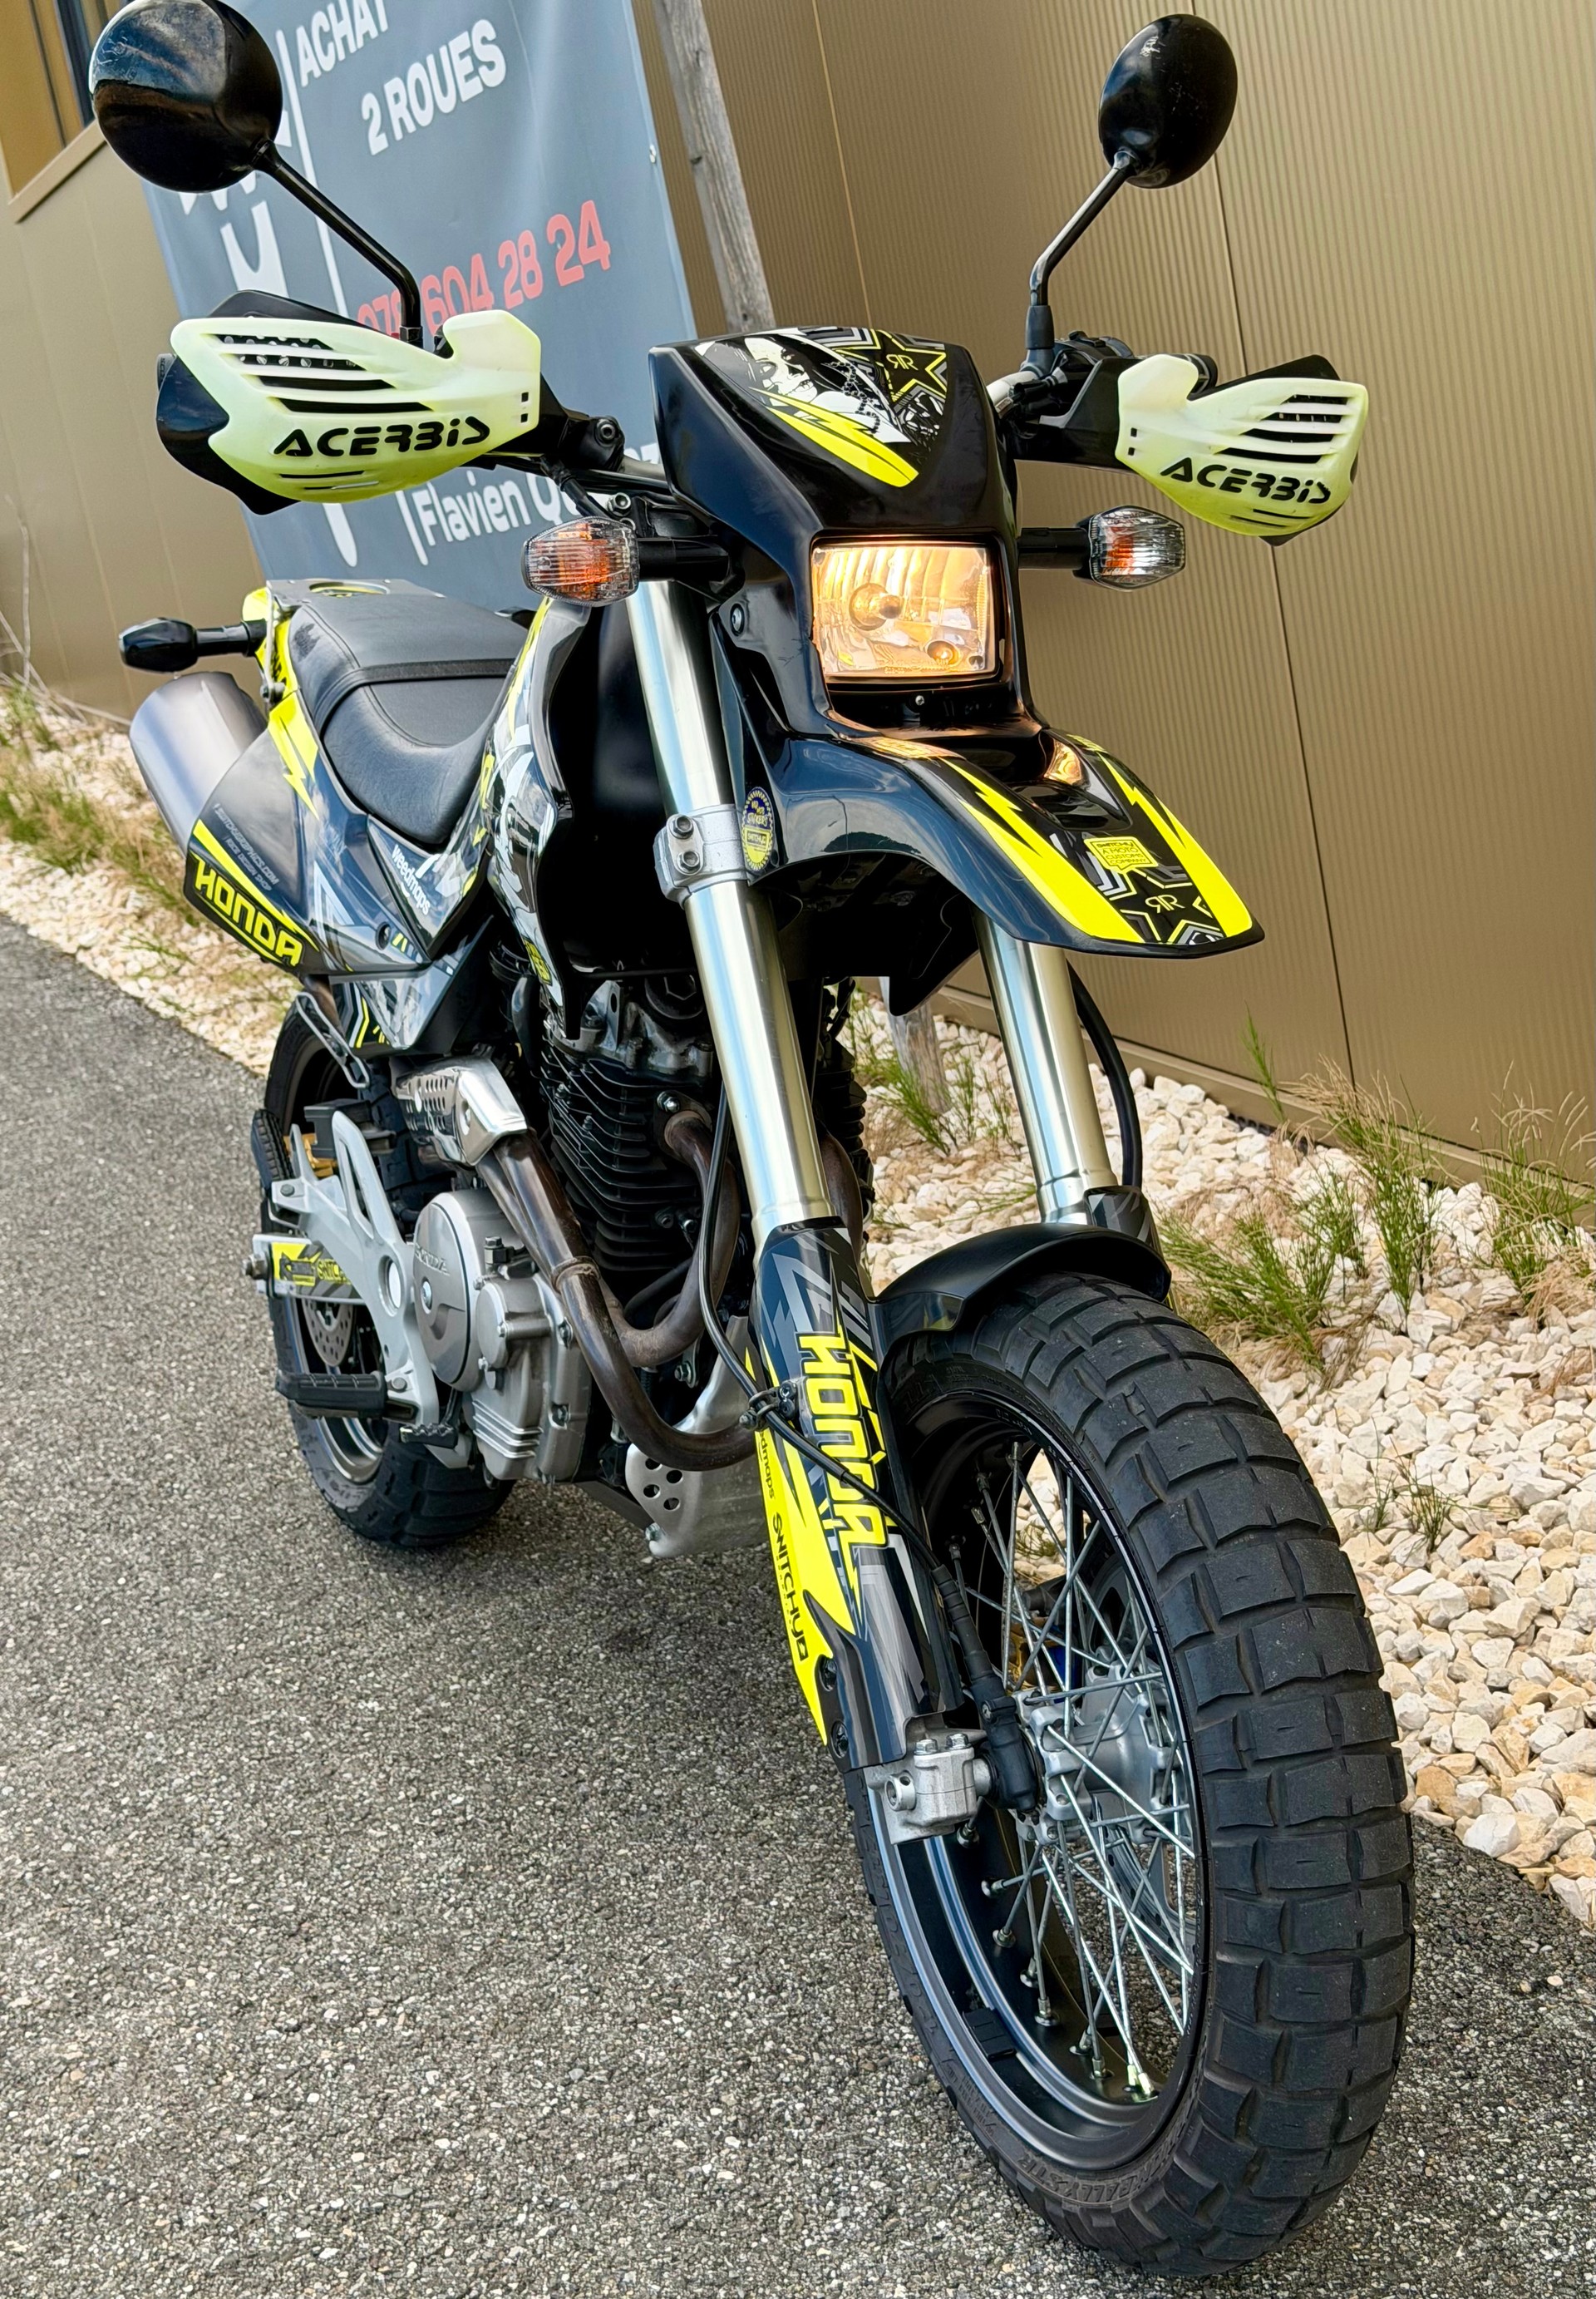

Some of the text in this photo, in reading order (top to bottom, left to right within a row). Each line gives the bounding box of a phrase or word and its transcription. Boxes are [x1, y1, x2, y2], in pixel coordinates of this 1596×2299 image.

[361, 19, 506, 155] 2 ROUES
[421, 253, 495, 337] 604
[498, 229, 544, 309] 28
[546, 200, 611, 287] 24
[412, 471, 531, 546] Flavien
[190, 852, 303, 967] HONDA
[392, 844, 431, 915] weedmaps
[799, 1330, 888, 1548] HONDA
[772, 1512, 805, 1639] SWITCHY
